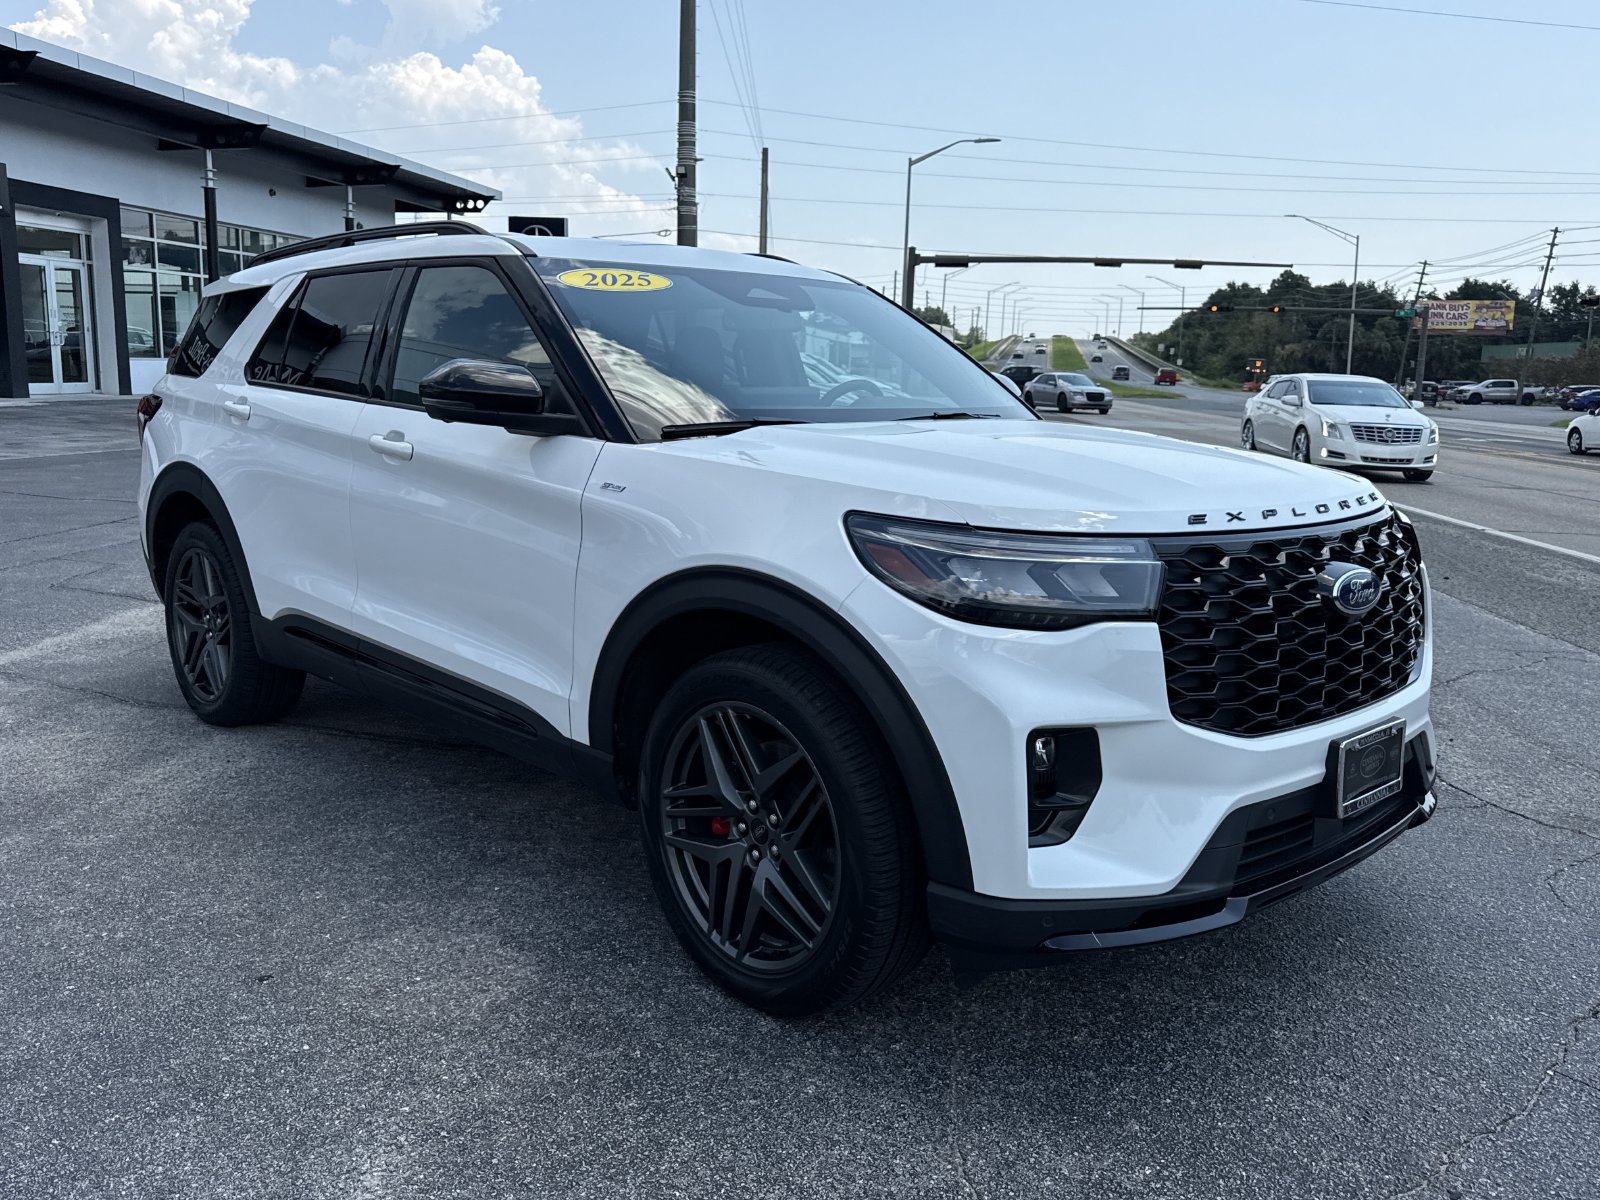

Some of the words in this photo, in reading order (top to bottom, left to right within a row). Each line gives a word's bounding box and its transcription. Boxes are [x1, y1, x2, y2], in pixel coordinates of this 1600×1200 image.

[582, 273, 652, 287] 2025
[1448, 303, 1471, 312] BUYS
[1446, 312, 1469, 321] CARS
[1187, 492, 1379, 525] EXPLORER
[1349, 578, 1376, 605] Ford
